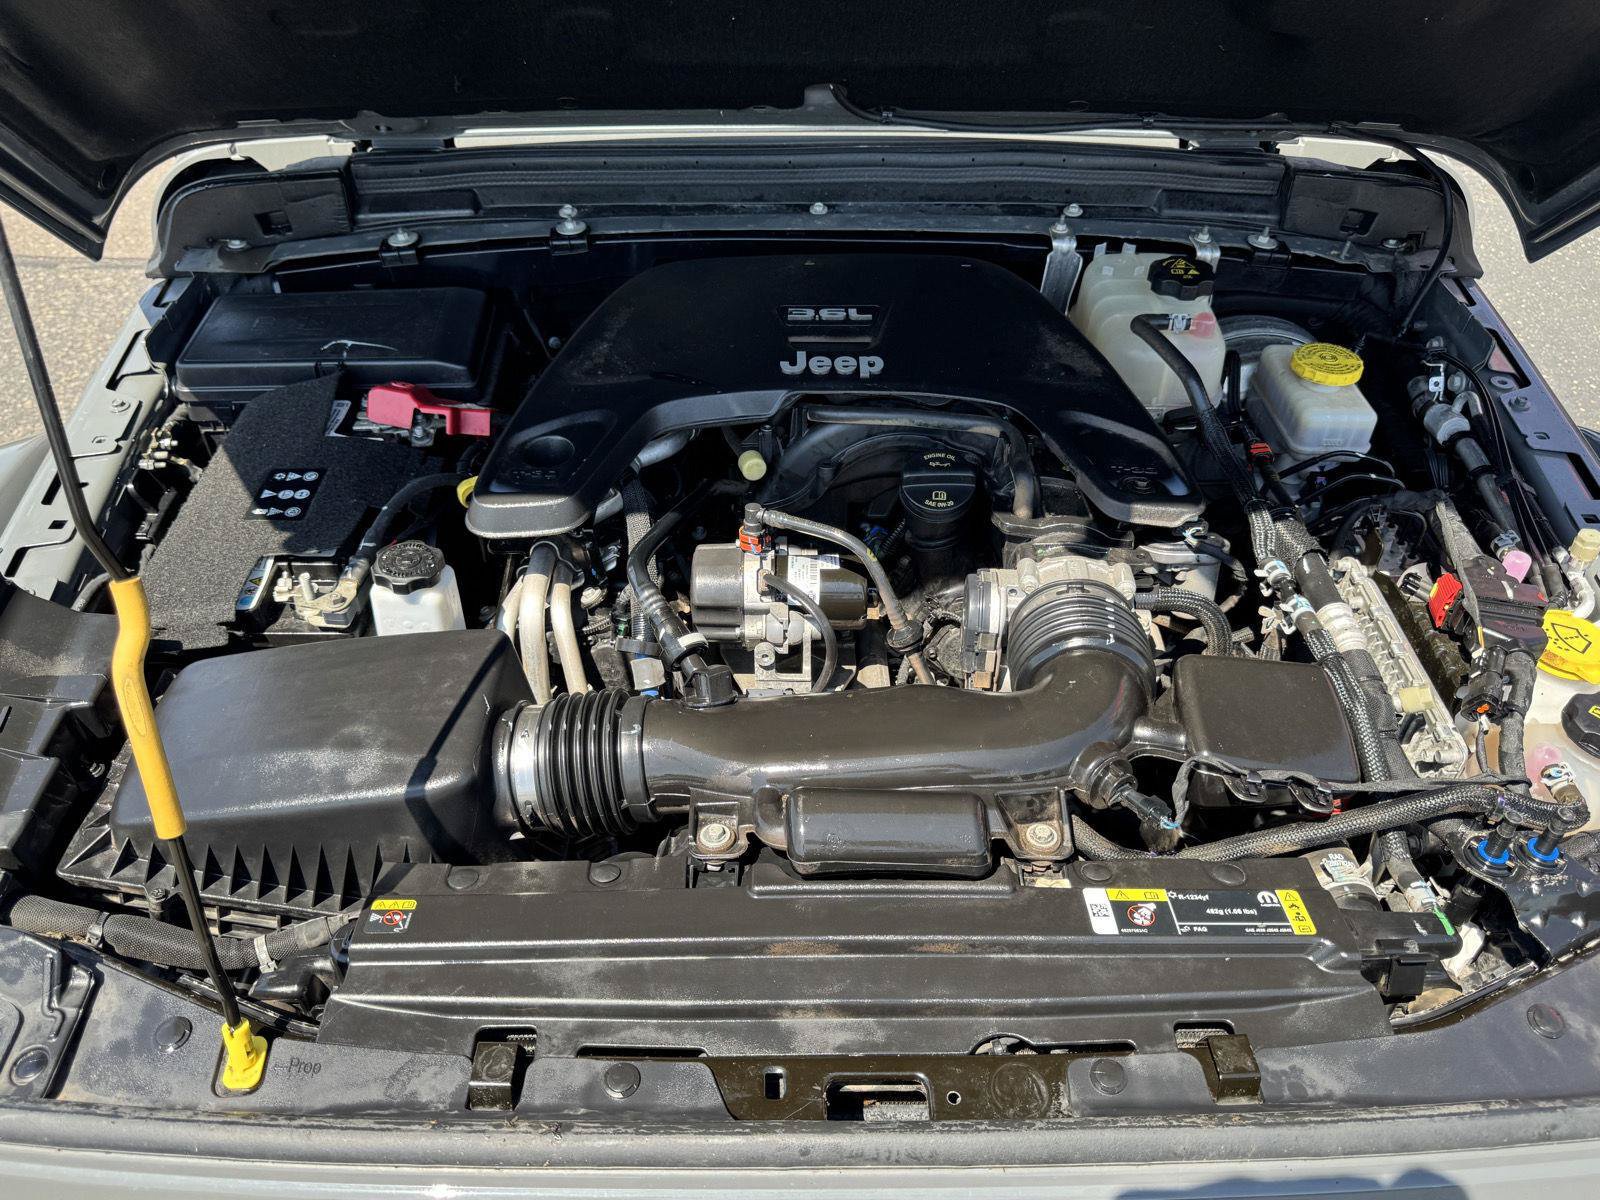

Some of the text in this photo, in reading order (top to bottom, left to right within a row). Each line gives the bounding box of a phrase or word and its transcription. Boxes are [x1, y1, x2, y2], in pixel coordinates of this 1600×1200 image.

[787, 308, 873, 321] 3.6L
[780, 350, 884, 379] Jeep
[923, 452, 956, 462] ENGINE OIL
[924, 499, 954, 508] SAE 0W-20
[288, 1056, 322, 1079] Prop
